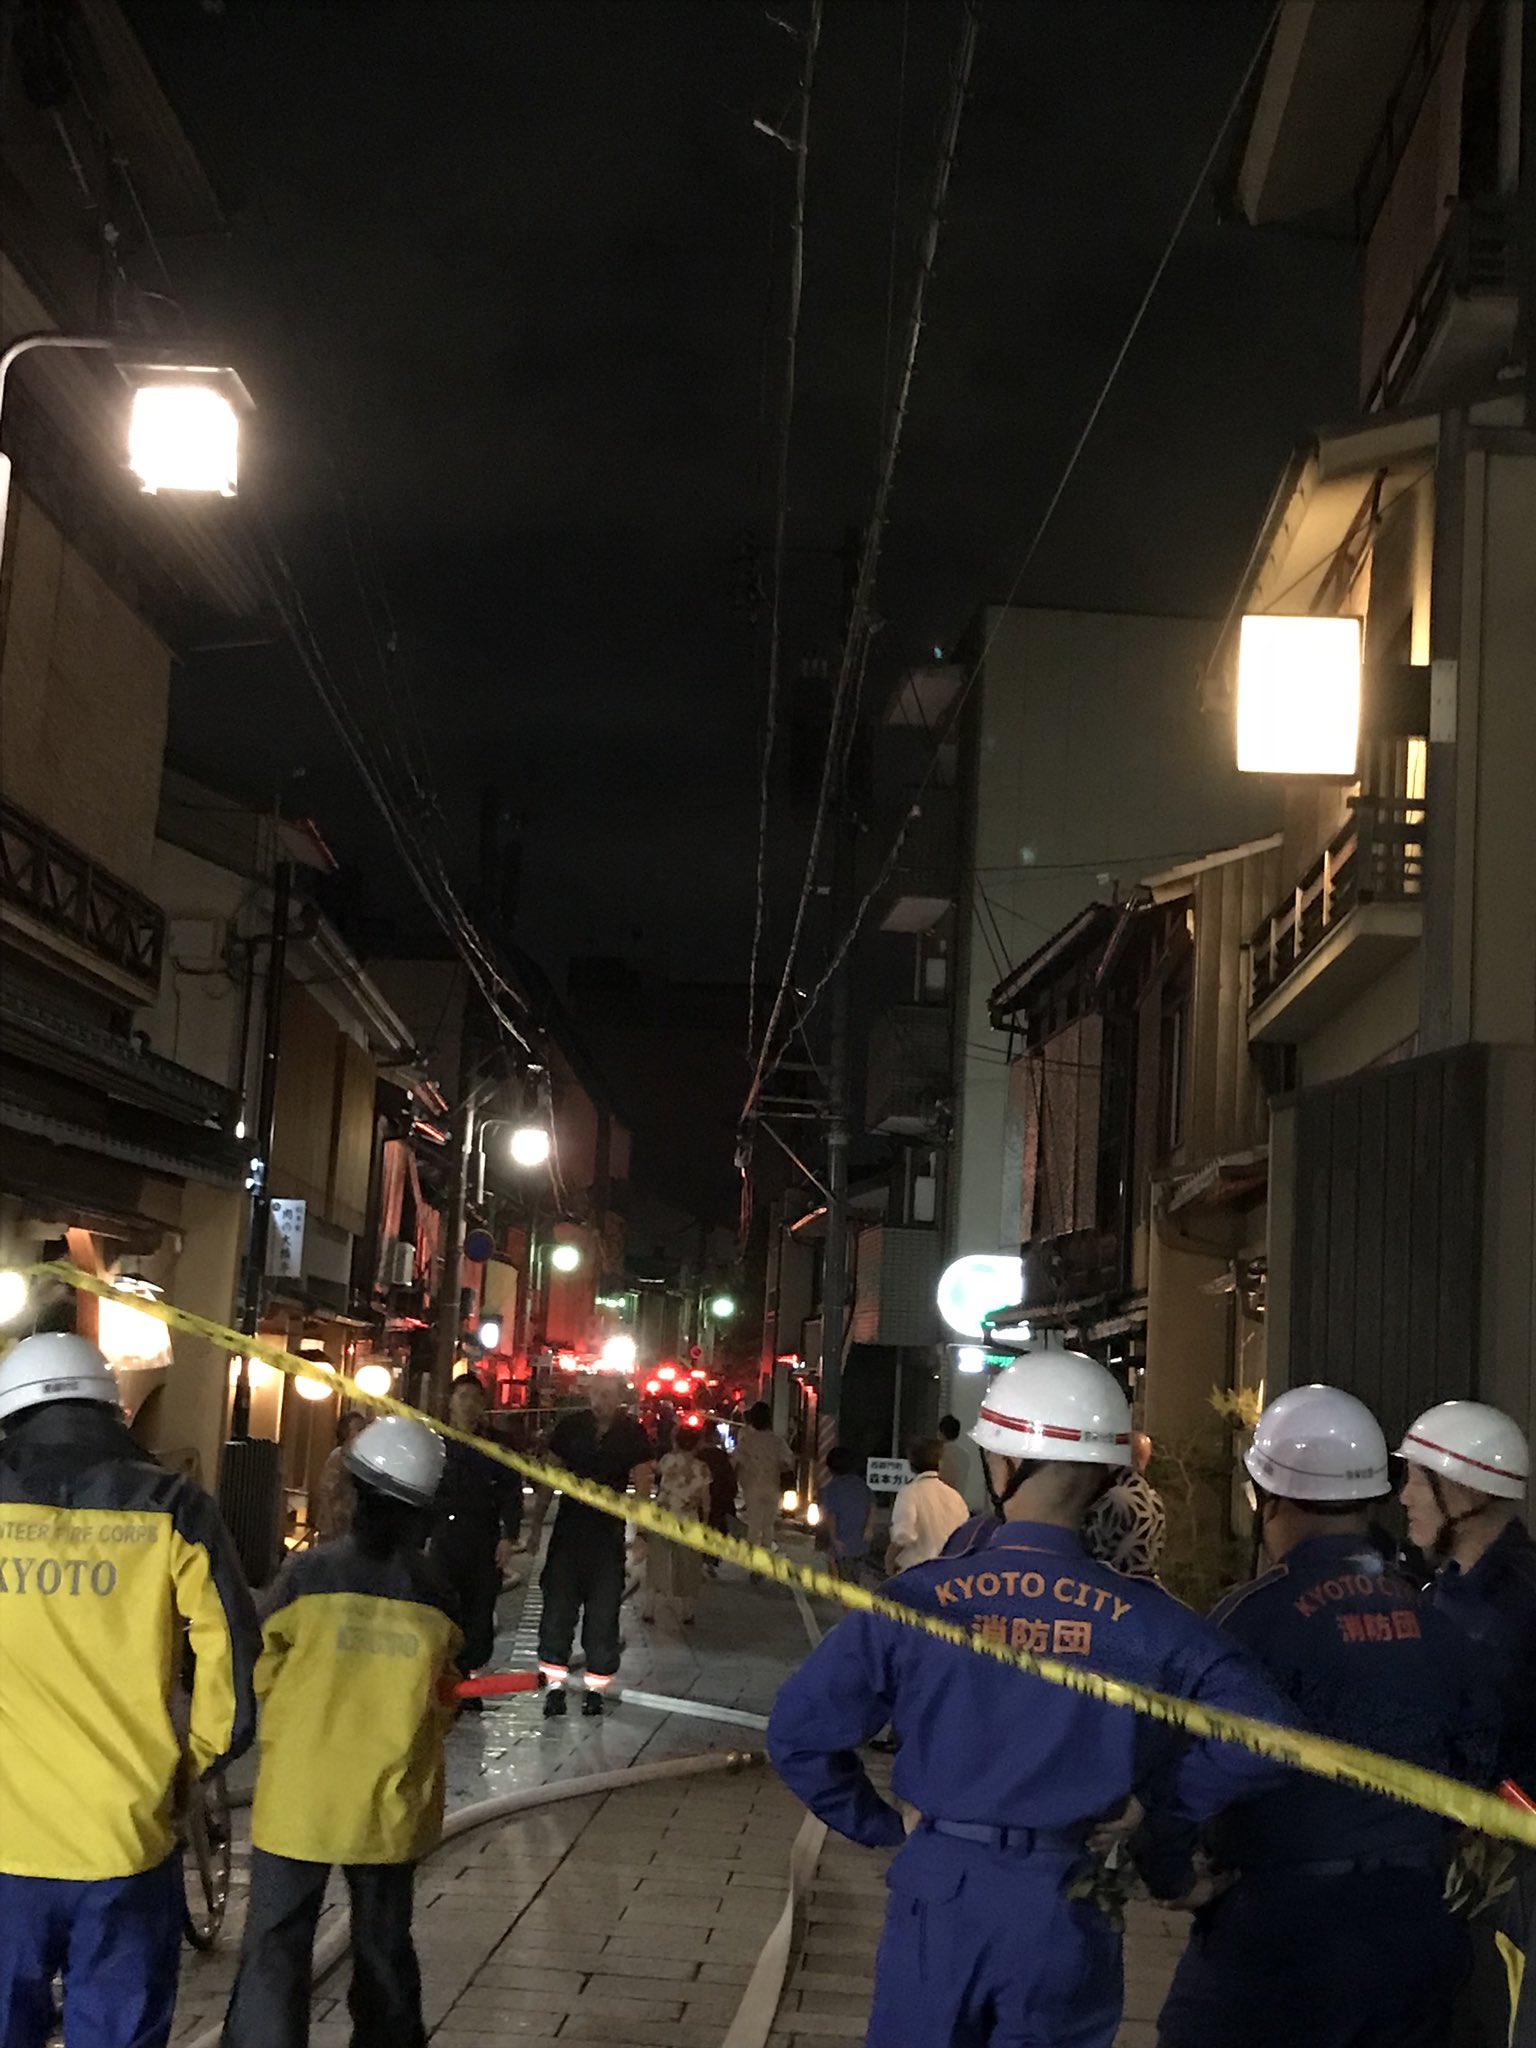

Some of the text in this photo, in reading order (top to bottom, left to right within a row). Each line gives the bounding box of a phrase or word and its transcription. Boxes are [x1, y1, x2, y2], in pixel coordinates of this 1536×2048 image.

[935, 1572, 1132, 1622] KYOTO CITY
[1294, 1573, 1374, 1617] KYOTO
[971, 1614, 1092, 1655] 消防団
[1337, 1609, 1421, 1641] 消防団
